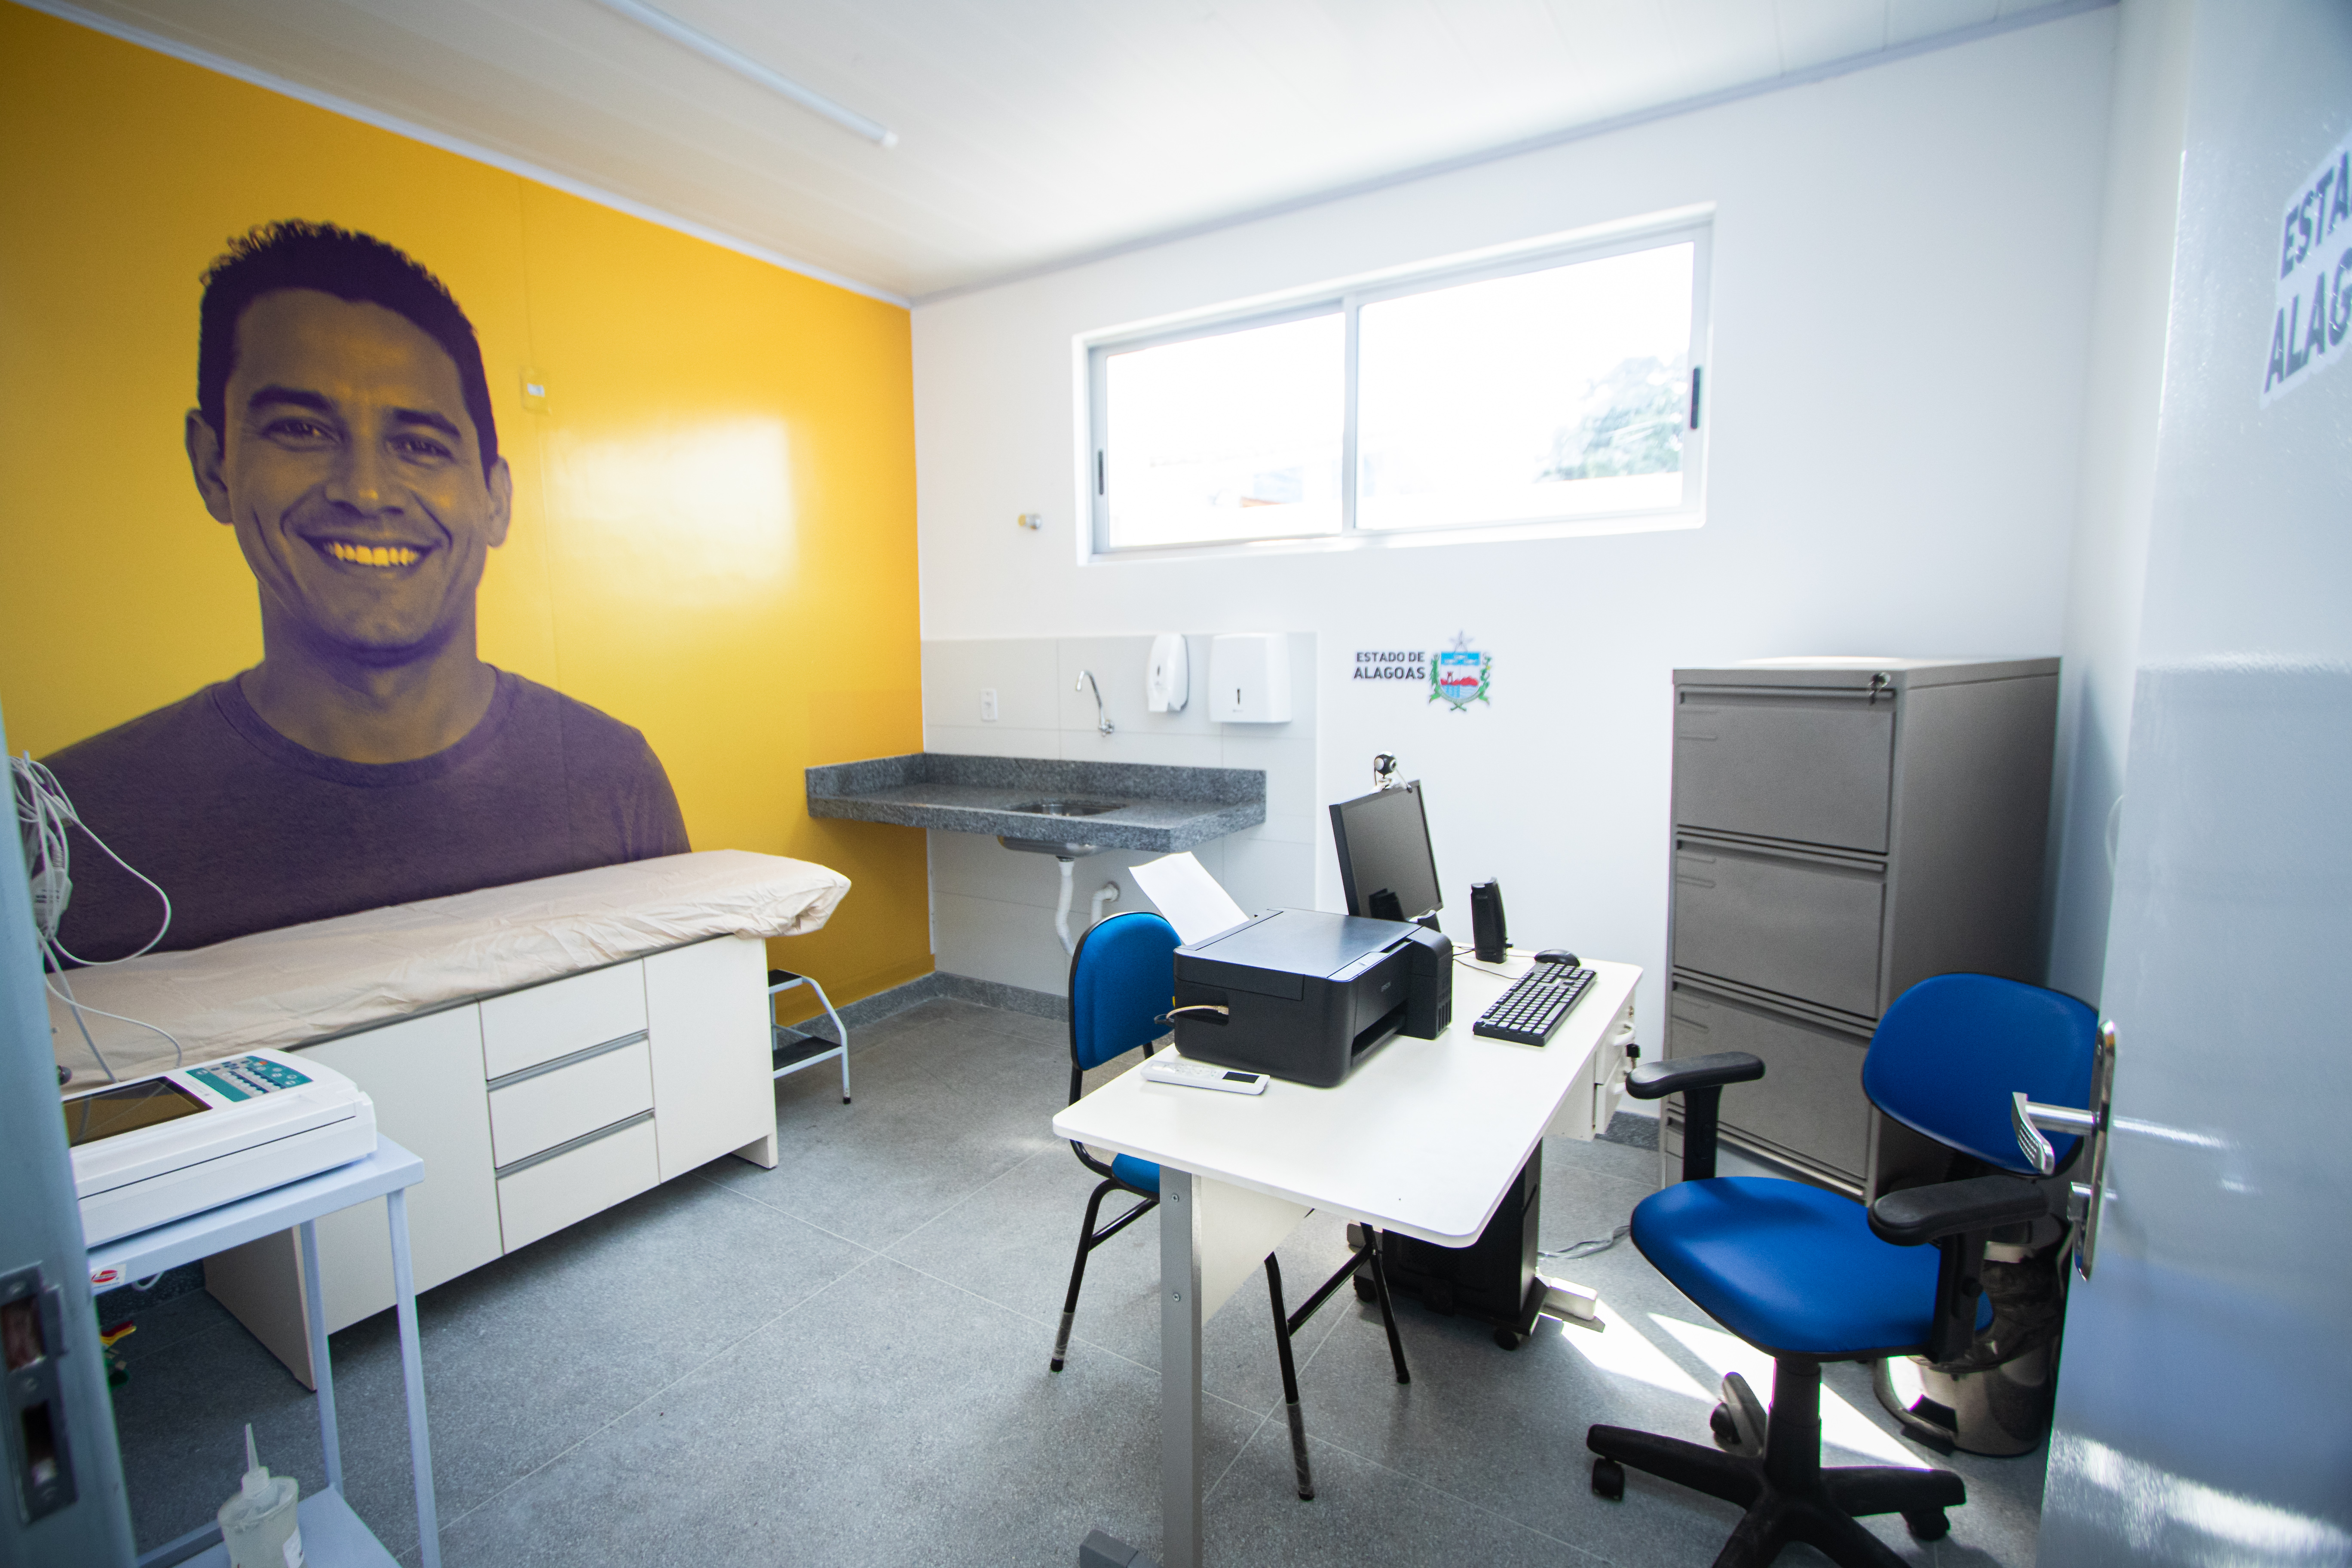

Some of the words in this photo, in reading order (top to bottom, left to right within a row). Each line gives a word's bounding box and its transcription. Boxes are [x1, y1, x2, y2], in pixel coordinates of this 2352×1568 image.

[1357, 652, 1405, 662] ESTADO
[1409, 652, 1425, 662] DE
[1354, 666, 1426, 679] ALAGOAS
